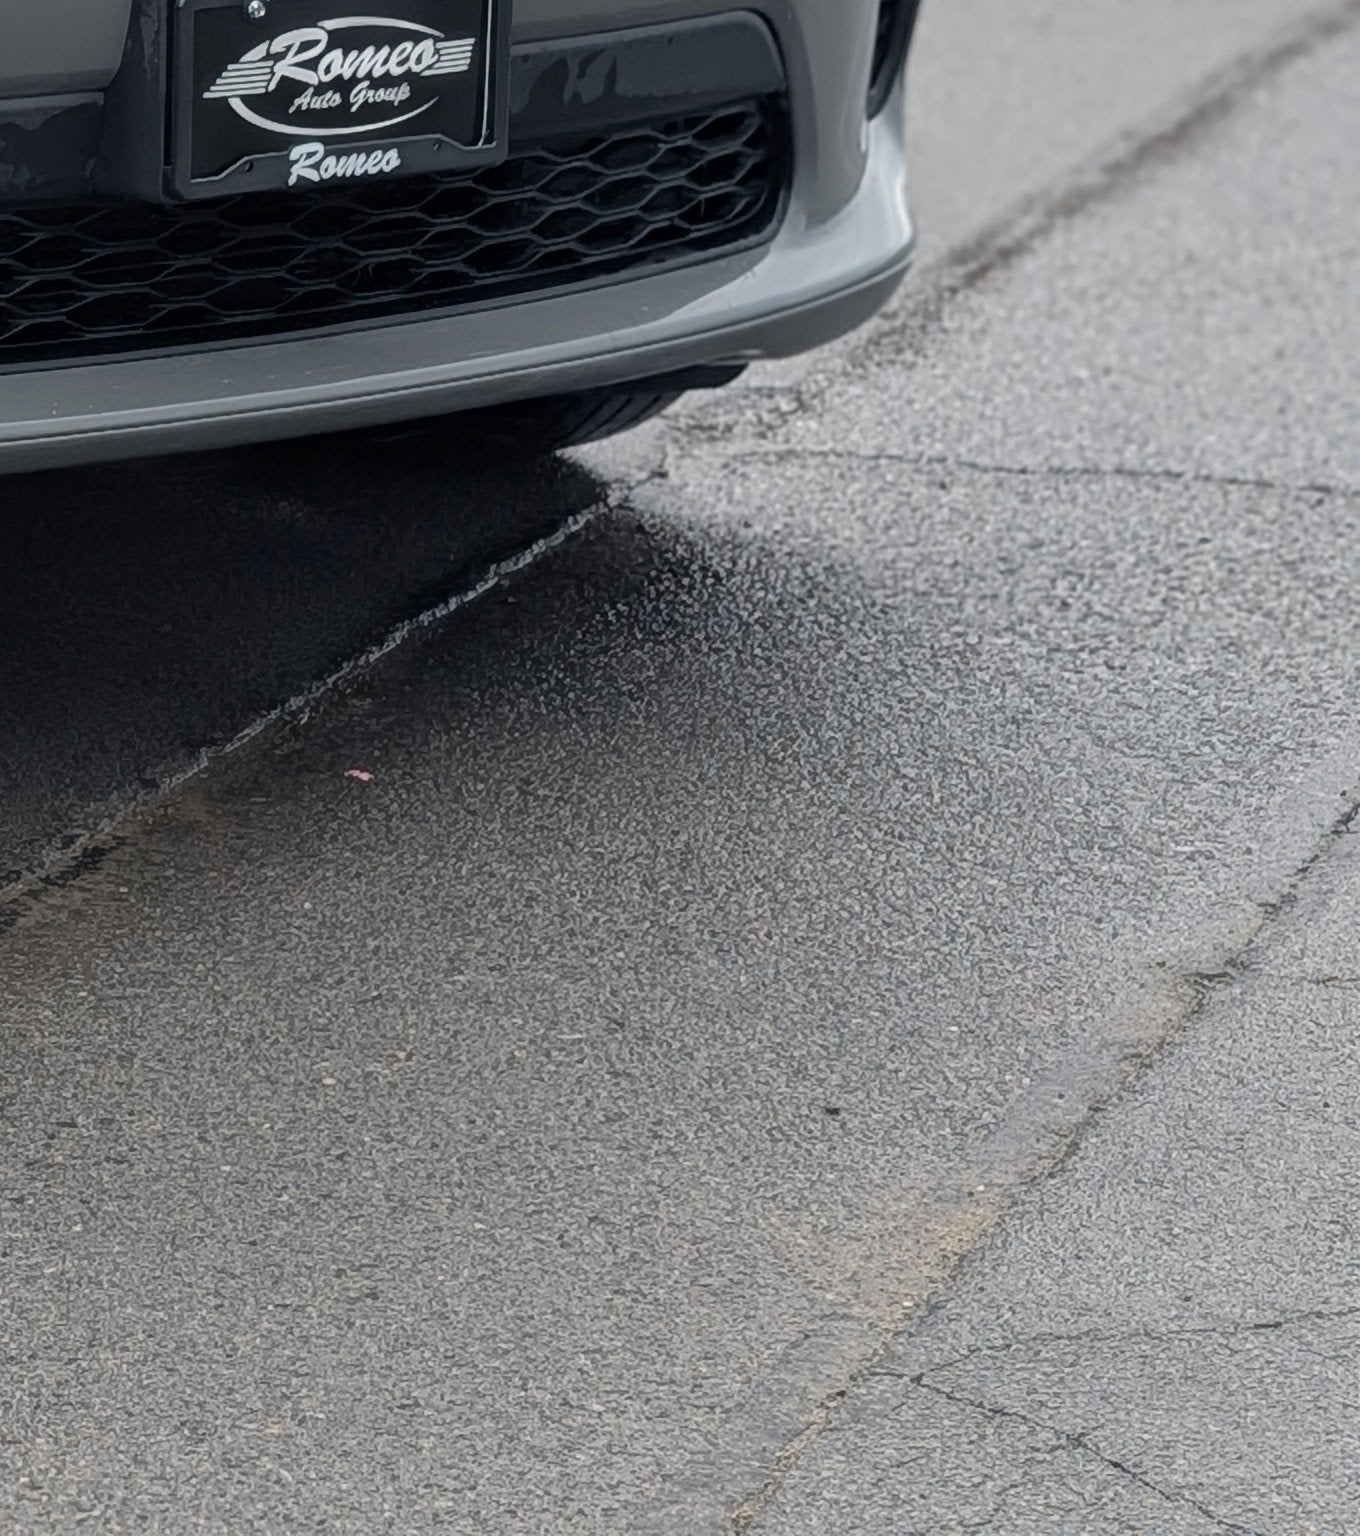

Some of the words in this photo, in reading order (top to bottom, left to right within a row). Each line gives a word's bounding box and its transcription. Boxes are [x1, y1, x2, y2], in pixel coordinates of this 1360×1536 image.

[267, 27, 440, 93] Romeo
[289, 87, 341, 114] Auto
[349, 80, 412, 114] Group
[288, 141, 402, 187] Romeo
